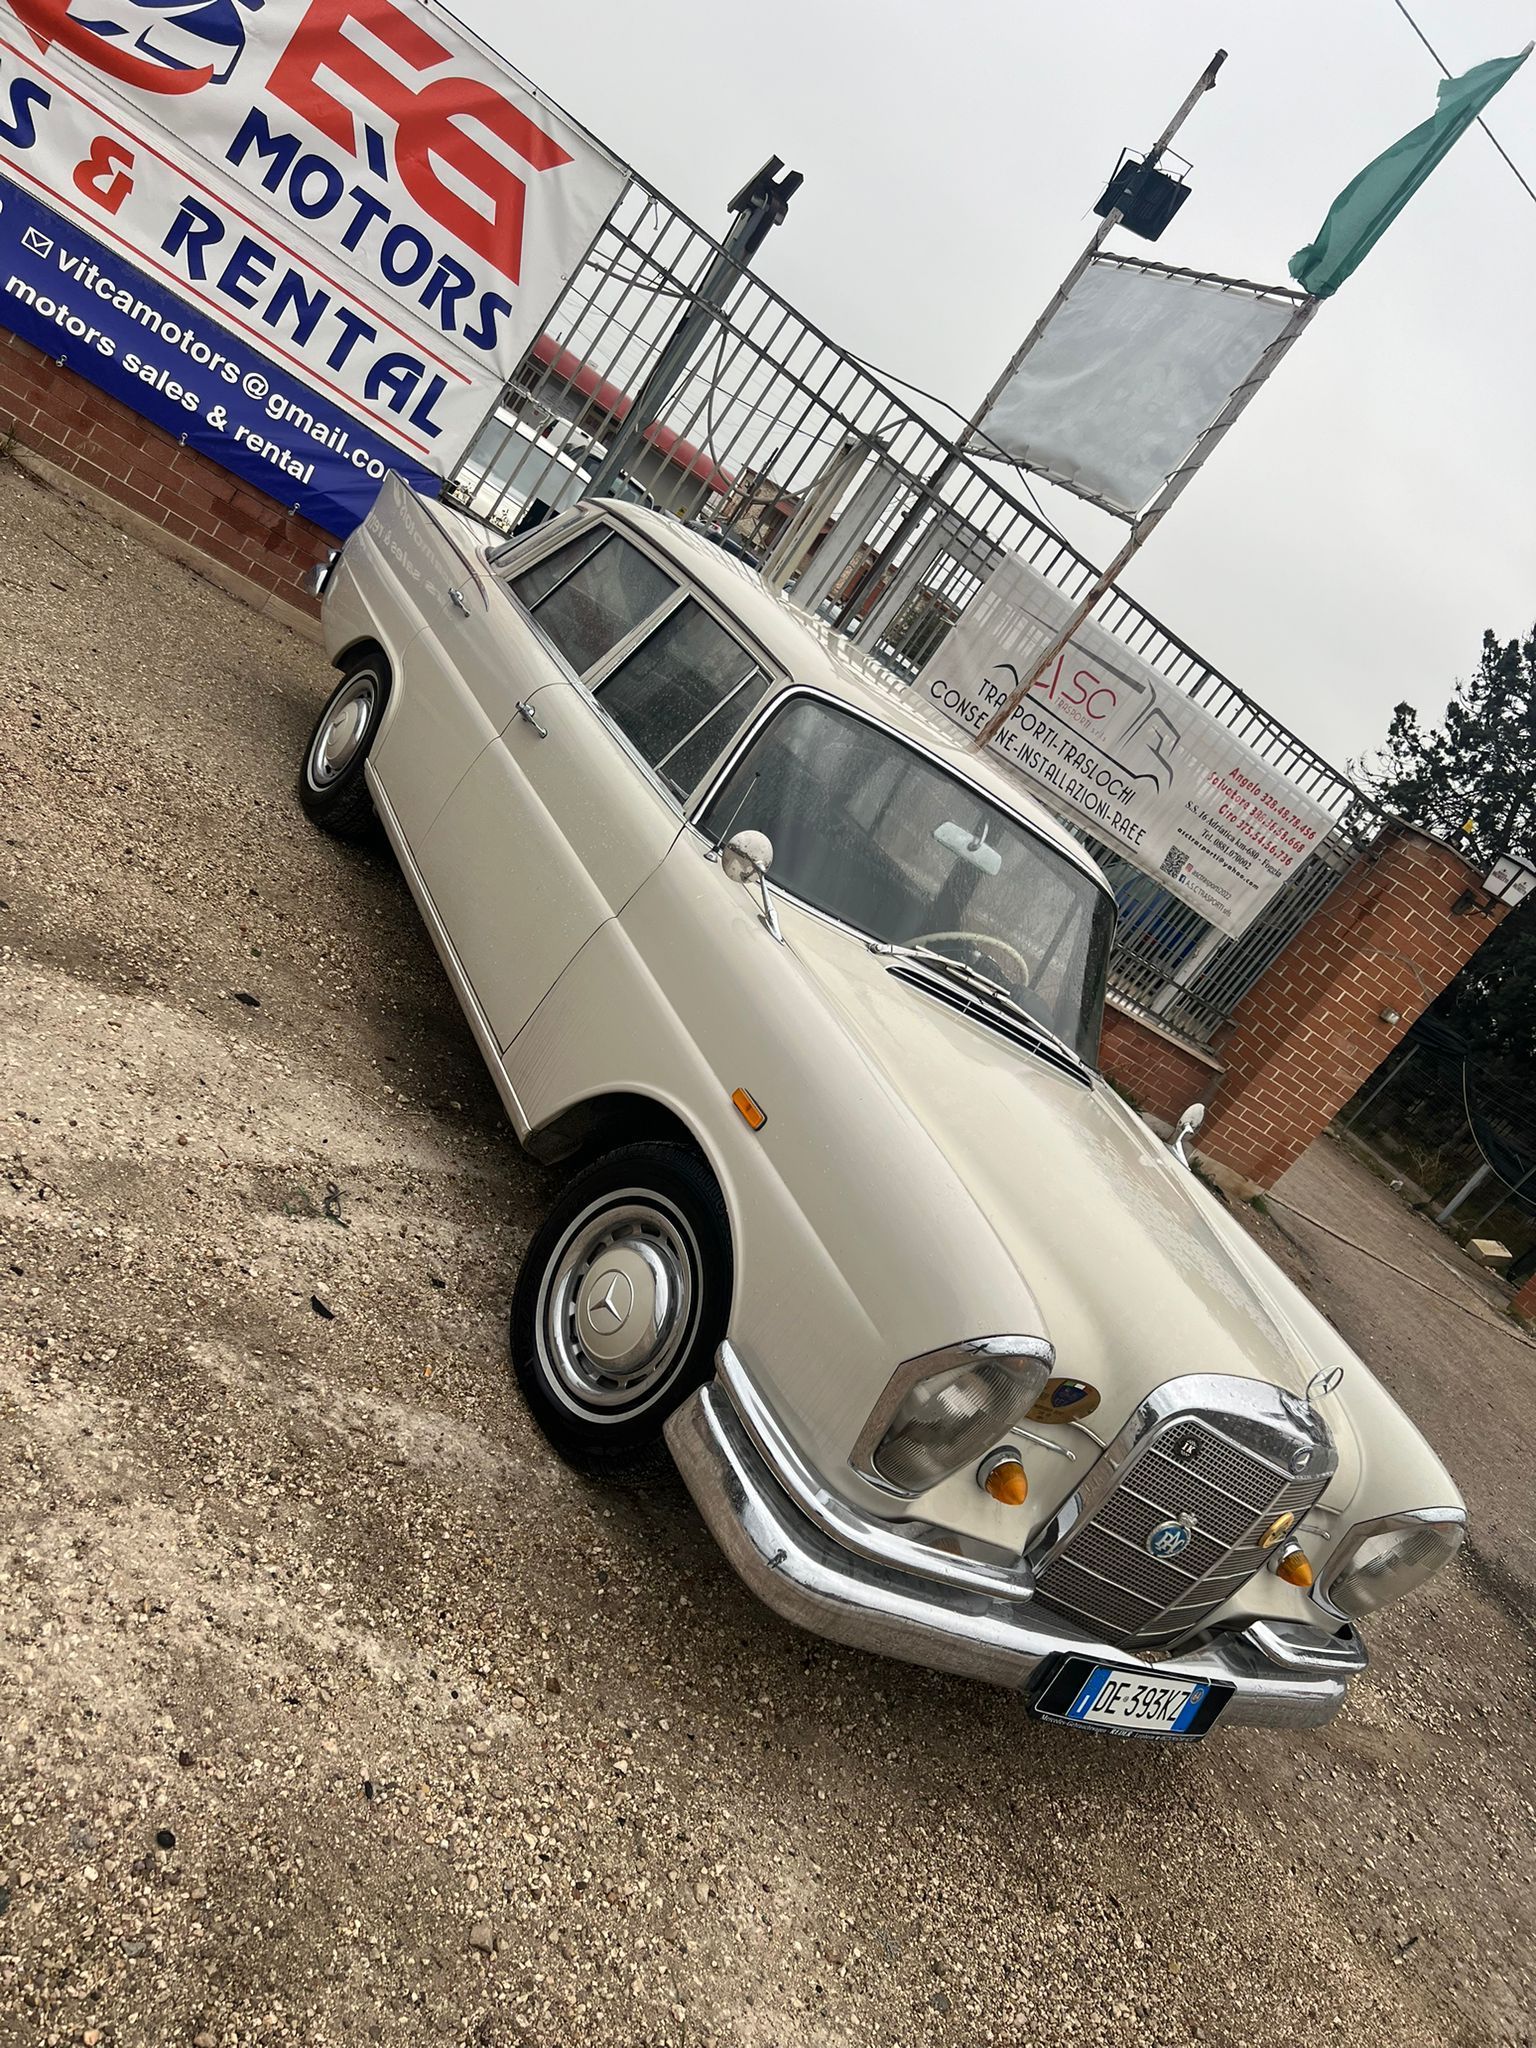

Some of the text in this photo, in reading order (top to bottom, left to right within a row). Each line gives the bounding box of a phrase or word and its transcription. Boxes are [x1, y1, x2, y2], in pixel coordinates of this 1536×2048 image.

[225, 106, 511, 351] MOTORS
[73, 136, 135, 216] &
[161, 194, 443, 438] RENTAL
[4, 275, 315, 485] motors sales & rental
[58, 248, 409, 484] vitcamotors@gmail.co
[930, 680, 1147, 846] CONSENE-INSTALLAZIONI-RAEE
[978, 678, 1137, 806] TRAPORTI-TRASLOCHI
[1054, 697, 1092, 730] TRASPORTI
[1184, 800, 1198, 815] S.S.
[1198, 811, 1208, 821] 16
[1206, 818, 1235, 843] Adriatica
[1261, 858, 1282, 879] Foggia
[1201, 829, 1213, 843] Tel.
[1207, 771, 1251, 810] Salvatore
[1218, 803, 1294, 867] Ciro 375.54.56.736
[1228, 767, 1317, 841] Angelo 328.48.78.456
